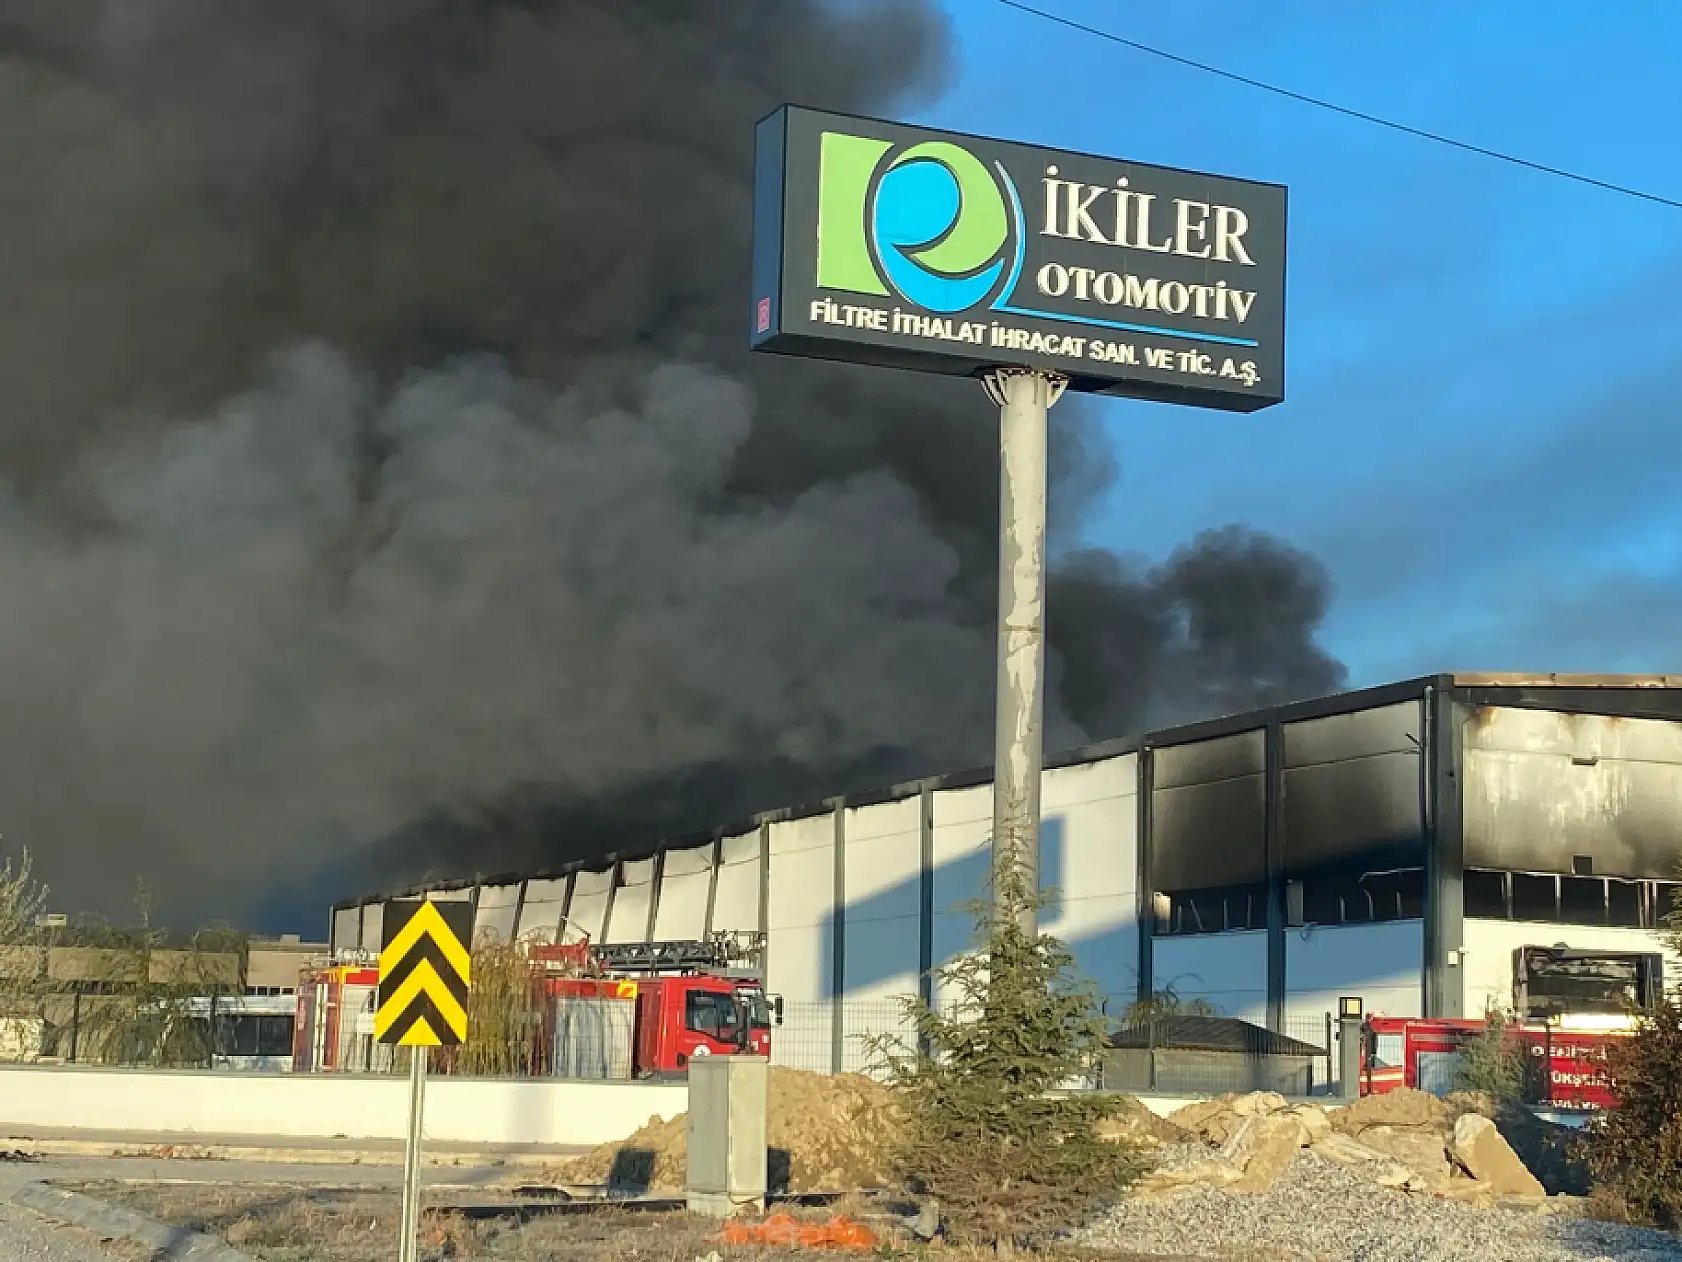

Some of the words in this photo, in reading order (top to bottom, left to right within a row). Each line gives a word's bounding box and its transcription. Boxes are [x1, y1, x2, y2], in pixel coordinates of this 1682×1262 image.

[1039, 165, 1257, 266] İKİLER
[1036, 262, 1257, 323] OTOMOTİV
[810, 296, 888, 332] FİLTRE
[893, 306, 987, 345] İTHALAT
[990, 320, 1087, 358] İHRACAT
[1088, 339, 1140, 365] SAN.
[1143, 346, 1175, 371] VE
[1176, 349, 1217, 376] TİC.
[1219, 358, 1261, 387] A.Ş.
